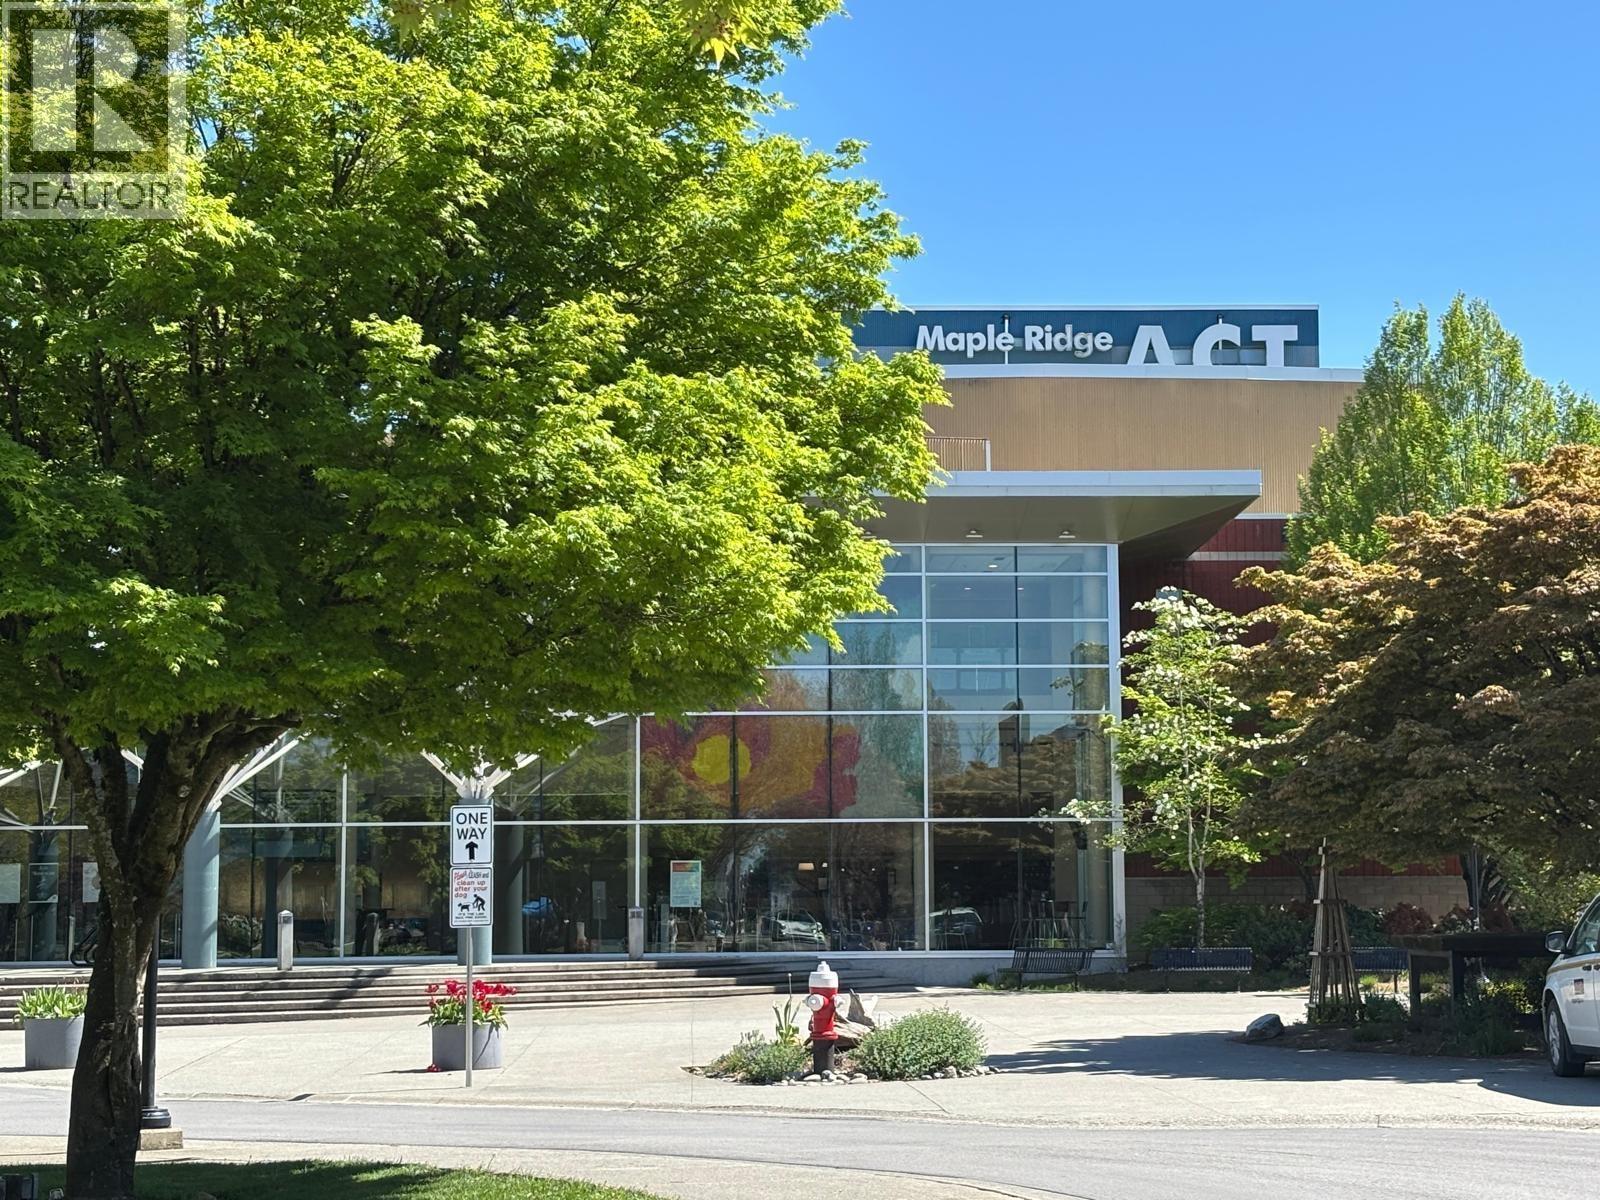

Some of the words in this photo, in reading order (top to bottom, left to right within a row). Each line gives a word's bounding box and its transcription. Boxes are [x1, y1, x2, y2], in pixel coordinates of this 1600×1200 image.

[916, 324, 1015, 358] Maple
[1024, 324, 1114, 358] Ridge
[1127, 323, 1298, 367] ACT
[456, 812, 488, 825] ONE
[456, 827, 487, 840] WAY
